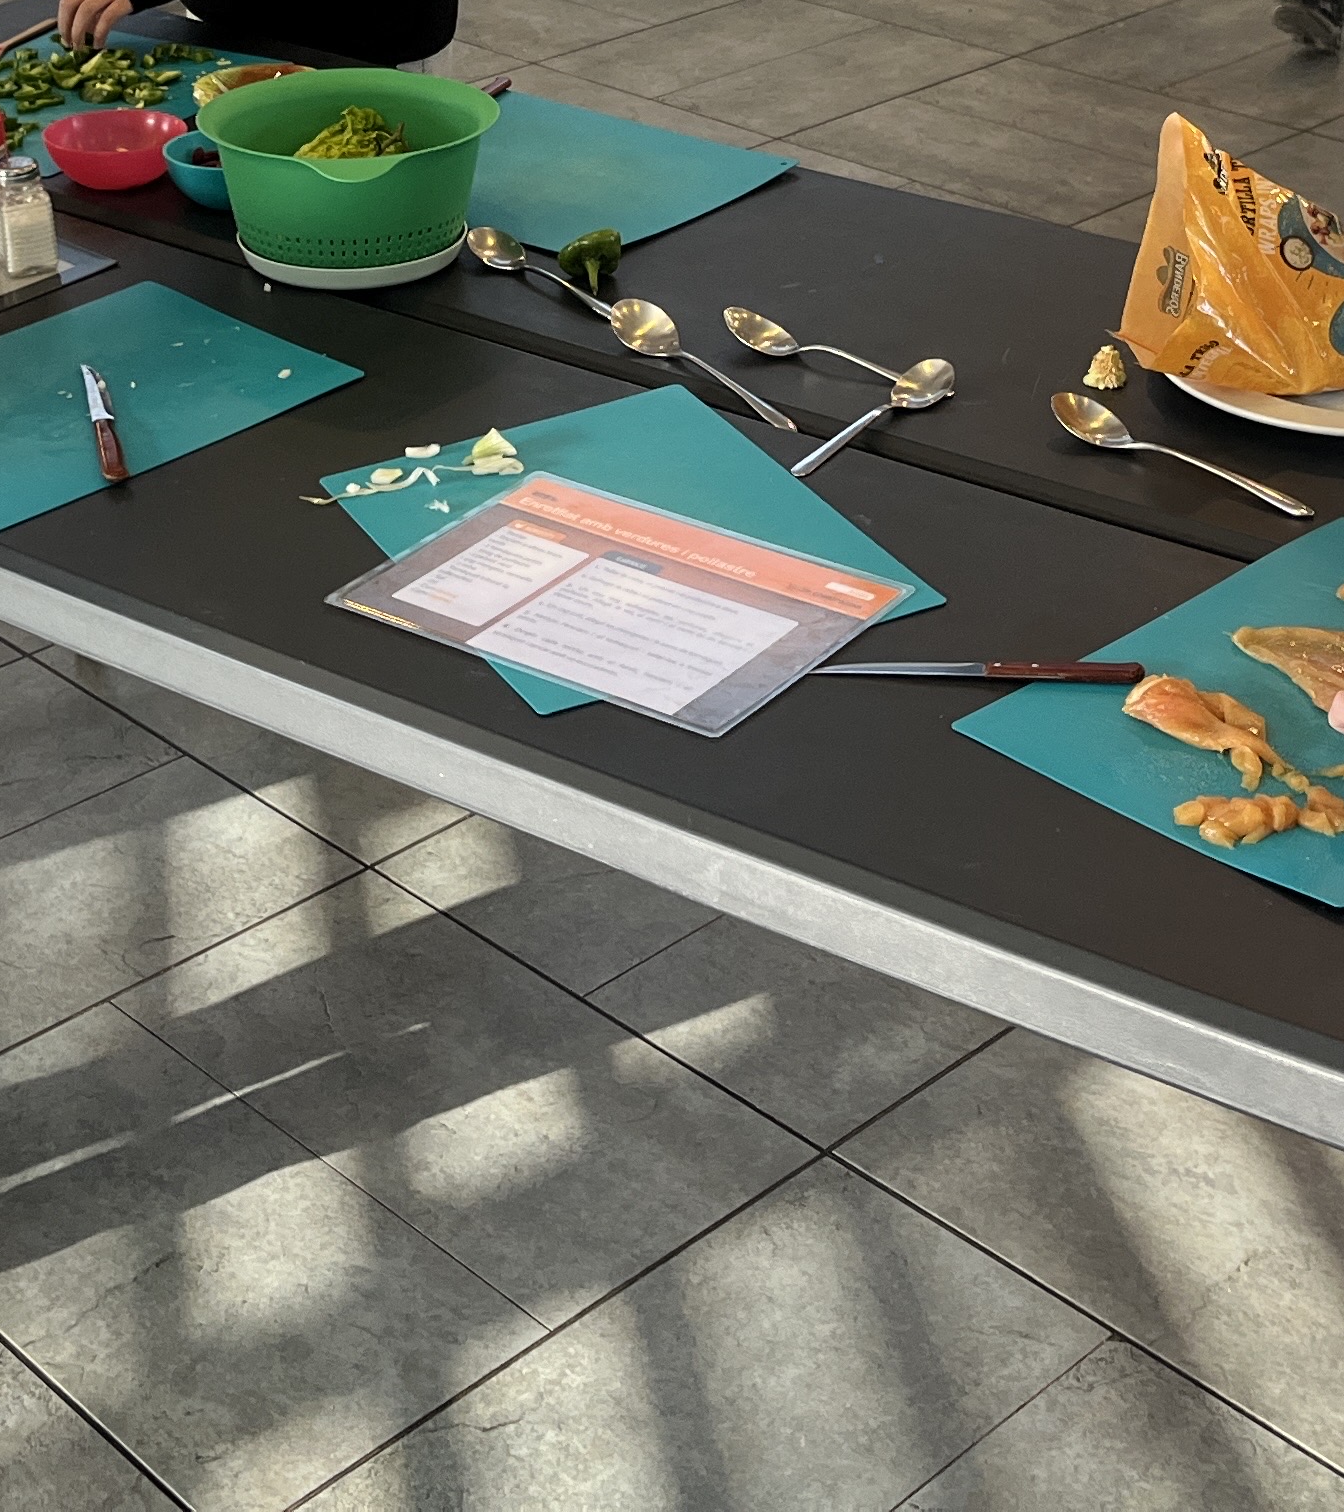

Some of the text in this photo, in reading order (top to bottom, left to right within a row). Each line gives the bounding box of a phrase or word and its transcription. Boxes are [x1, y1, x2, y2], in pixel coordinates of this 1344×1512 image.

[1258, 198, 1278, 256] WRAPS
[579, 517, 614, 532] amb
[614, 528, 681, 553] verdures
[686, 553, 756, 578] pollastre
